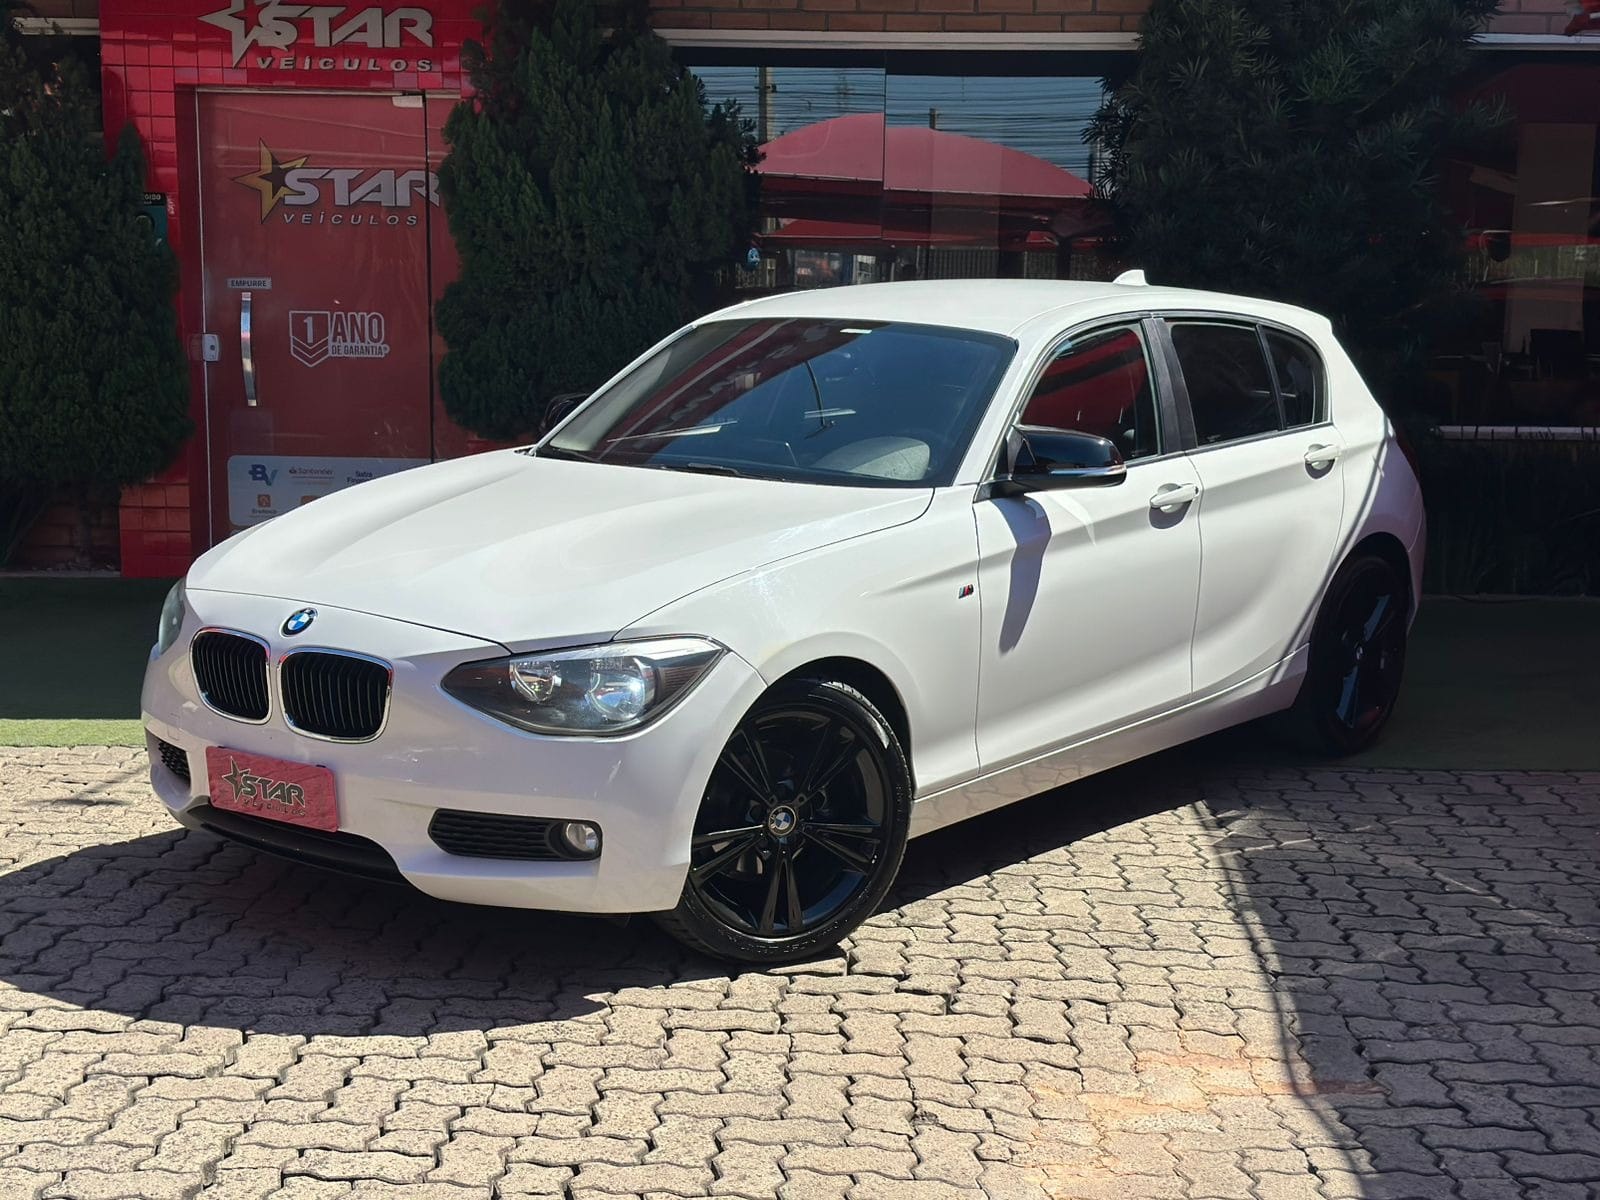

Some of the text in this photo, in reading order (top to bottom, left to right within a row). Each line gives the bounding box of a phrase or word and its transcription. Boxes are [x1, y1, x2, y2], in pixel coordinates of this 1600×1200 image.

[257, 2, 433, 50] STAR
[256, 56, 434, 72] VEÍCULOS
[284, 168, 440, 207] STAR
[283, 211, 418, 225] VEÍCULOS
[230, 279, 267, 288] EMPURRE
[304, 312, 384, 344] 1 ANO
[331, 345, 383, 356] DE GARANTIA
[240, 773, 306, 808] STAR
